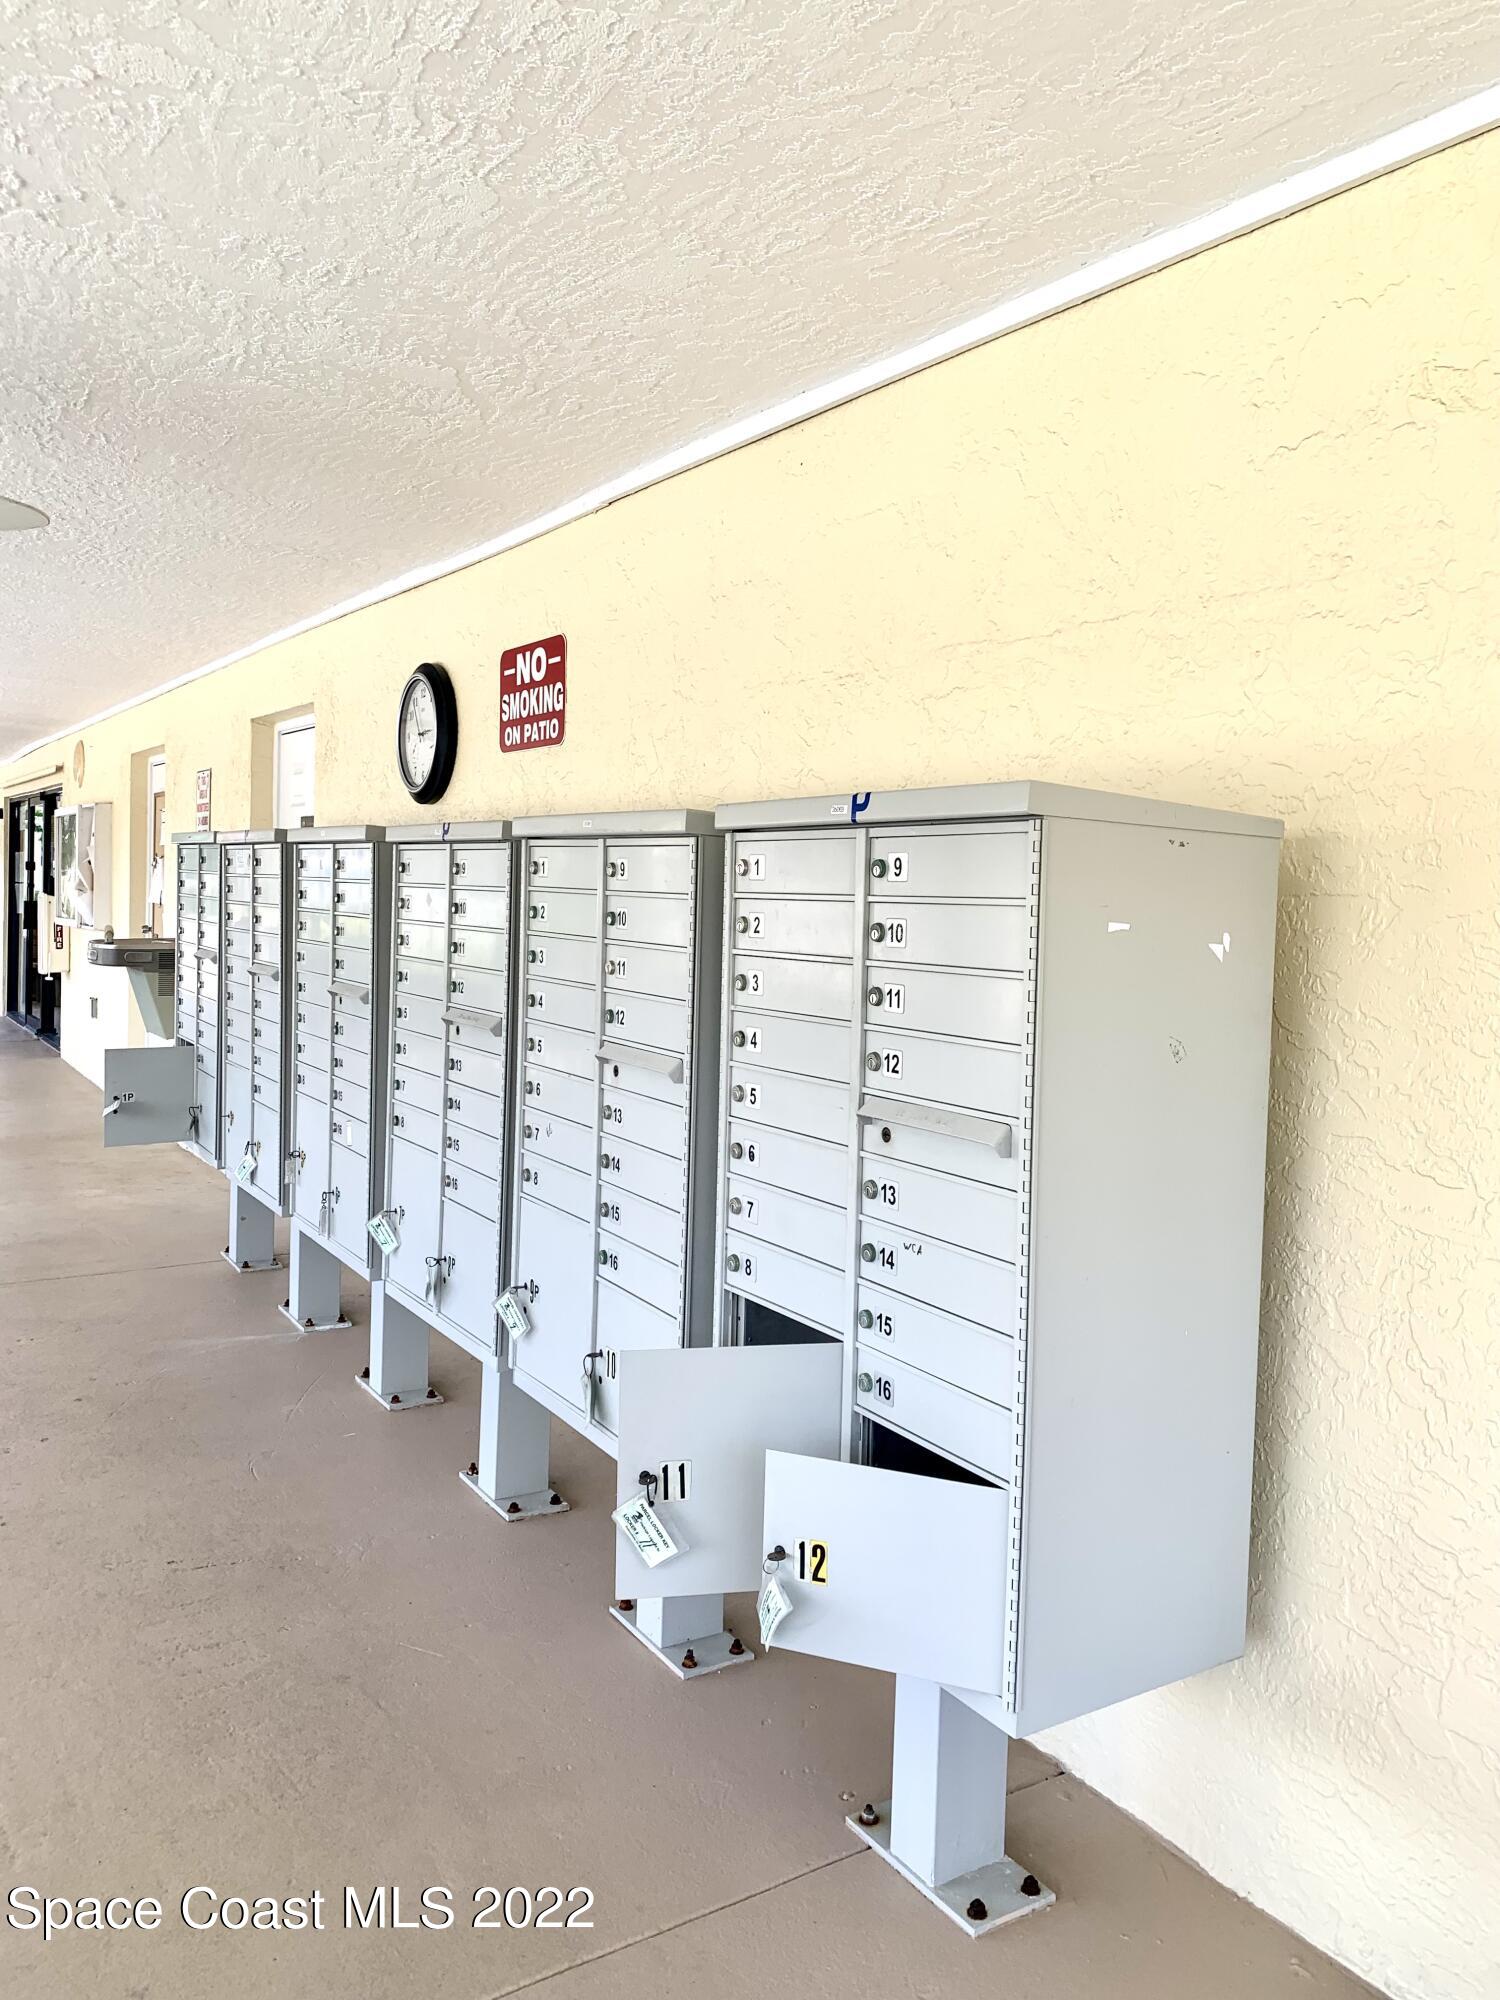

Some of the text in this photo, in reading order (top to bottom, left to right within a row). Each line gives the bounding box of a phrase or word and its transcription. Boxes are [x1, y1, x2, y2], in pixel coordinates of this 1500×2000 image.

[502, 682, 563, 721] SMOKING
[505, 718, 559, 746] ON PATIO
[541, 861, 545, 874] 1
[620, 862, 625, 876] 9
[754, 858, 760, 876] 1
[894, 857, 902, 877] 9
[540, 906, 545, 919] 2
[618, 911, 626, 926] 10
[753, 917, 760, 934] 2
[888, 923, 904, 943] 10
[539, 950, 544, 963] 3
[617, 960, 626, 975] 11
[752, 975, 759, 992] 3
[538, 995, 543, 1008] 4
[886, 988, 900, 1008] 11
[616, 1010, 625, 1025] 12
[537, 1040, 542, 1053] 5
[750, 1032, 757, 1048] 4
[884, 1053, 899, 1074] 12
[122, 1093, 134, 1102] 1P
[536, 1083, 540, 1096] 6
[750, 1088, 756, 1104] 5
[613, 1108, 622, 1123] 13
[535, 1127, 540, 1140] 7
[748, 1145, 755, 1162] 6
[611, 1156, 620, 1172] 14
[533, 1172, 538, 1185] 8
[881, 1183, 896, 1205] 13
[610, 1207, 620, 1221] 15
[747, 1201, 754, 1218] 7
[609, 1256, 618, 1271] 16
[879, 1247, 894, 1269] 14
[745, 1258, 752, 1276] 8
[877, 1313, 892, 1336] 15
[876, 1377, 891, 1400] 16
[662, 1462, 686, 1500] 11
[623, 1513, 637, 1531] LOCKER
[650, 1521, 664, 1540] LOCKER
[662, 1538, 670, 1549] KEY
[799, 1541, 826, 1583] 12
